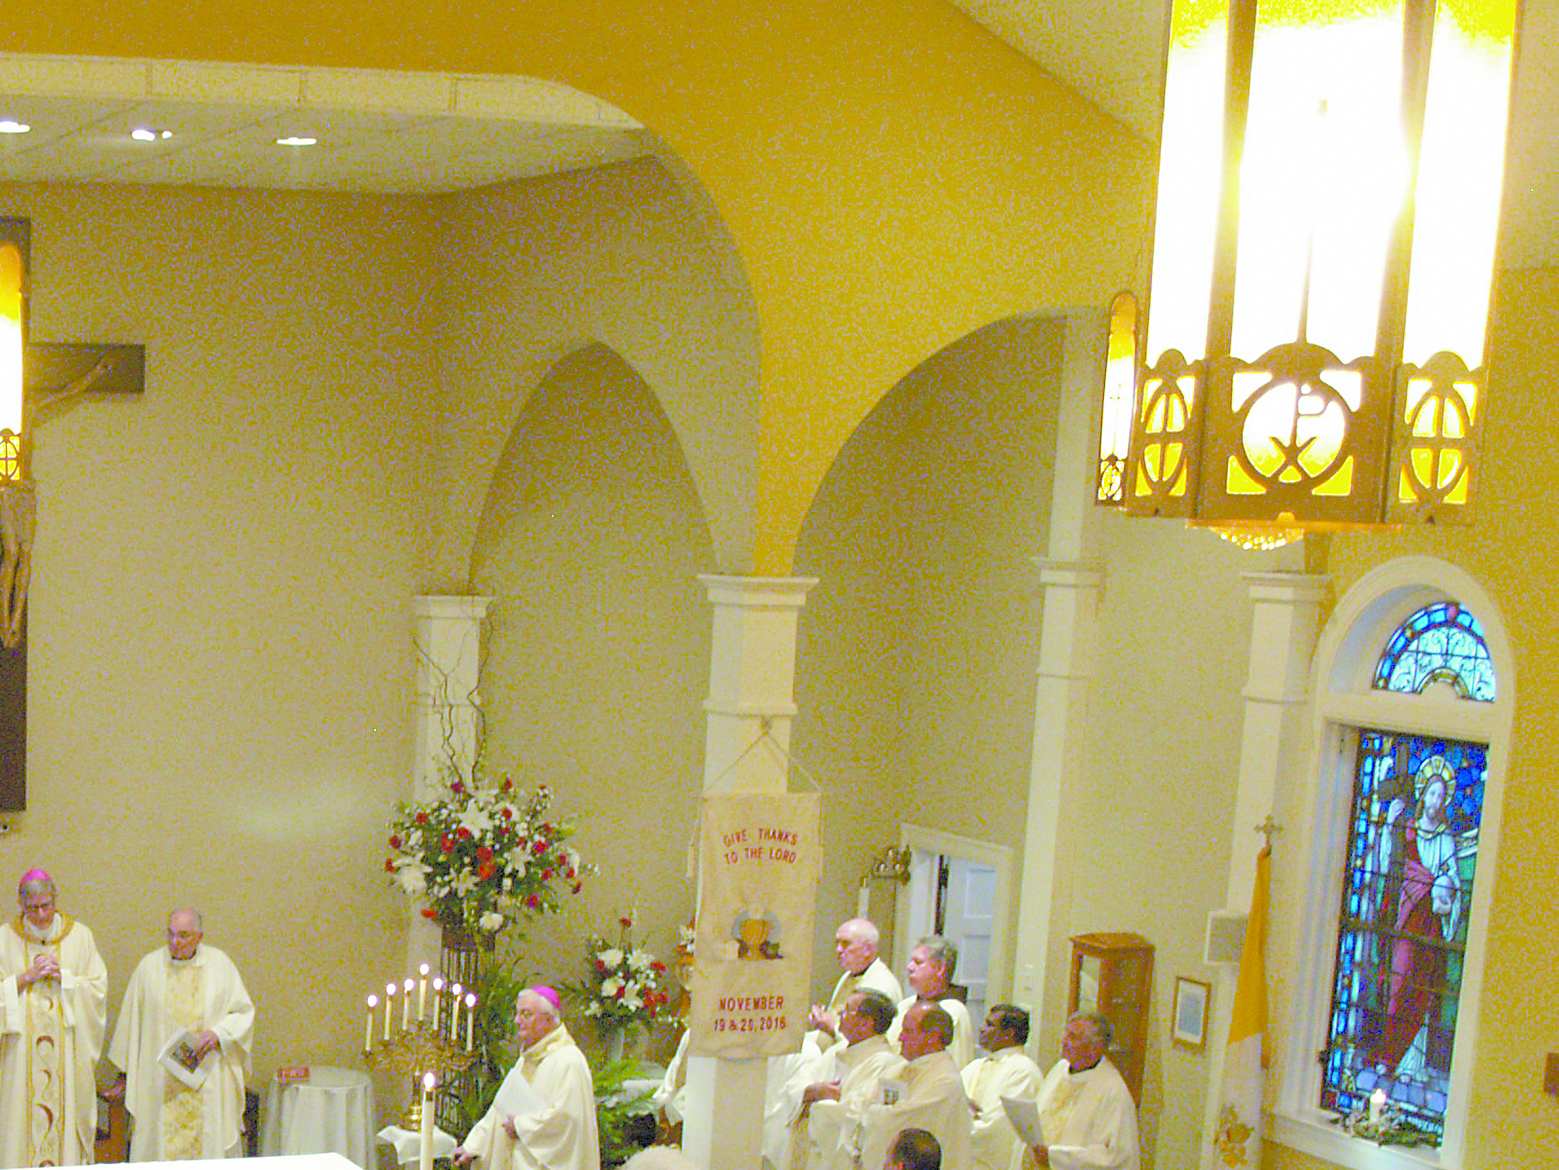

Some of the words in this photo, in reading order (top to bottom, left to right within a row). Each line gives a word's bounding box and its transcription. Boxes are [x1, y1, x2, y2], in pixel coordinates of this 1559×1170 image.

[723, 830, 747, 848] GIVE
[759, 828, 798, 845] THANKS
[724, 851, 738, 865] TO
[744, 846, 763, 859] THE
[768, 846, 796, 864] LORD
[719, 995, 784, 1011] NOVEMBER
